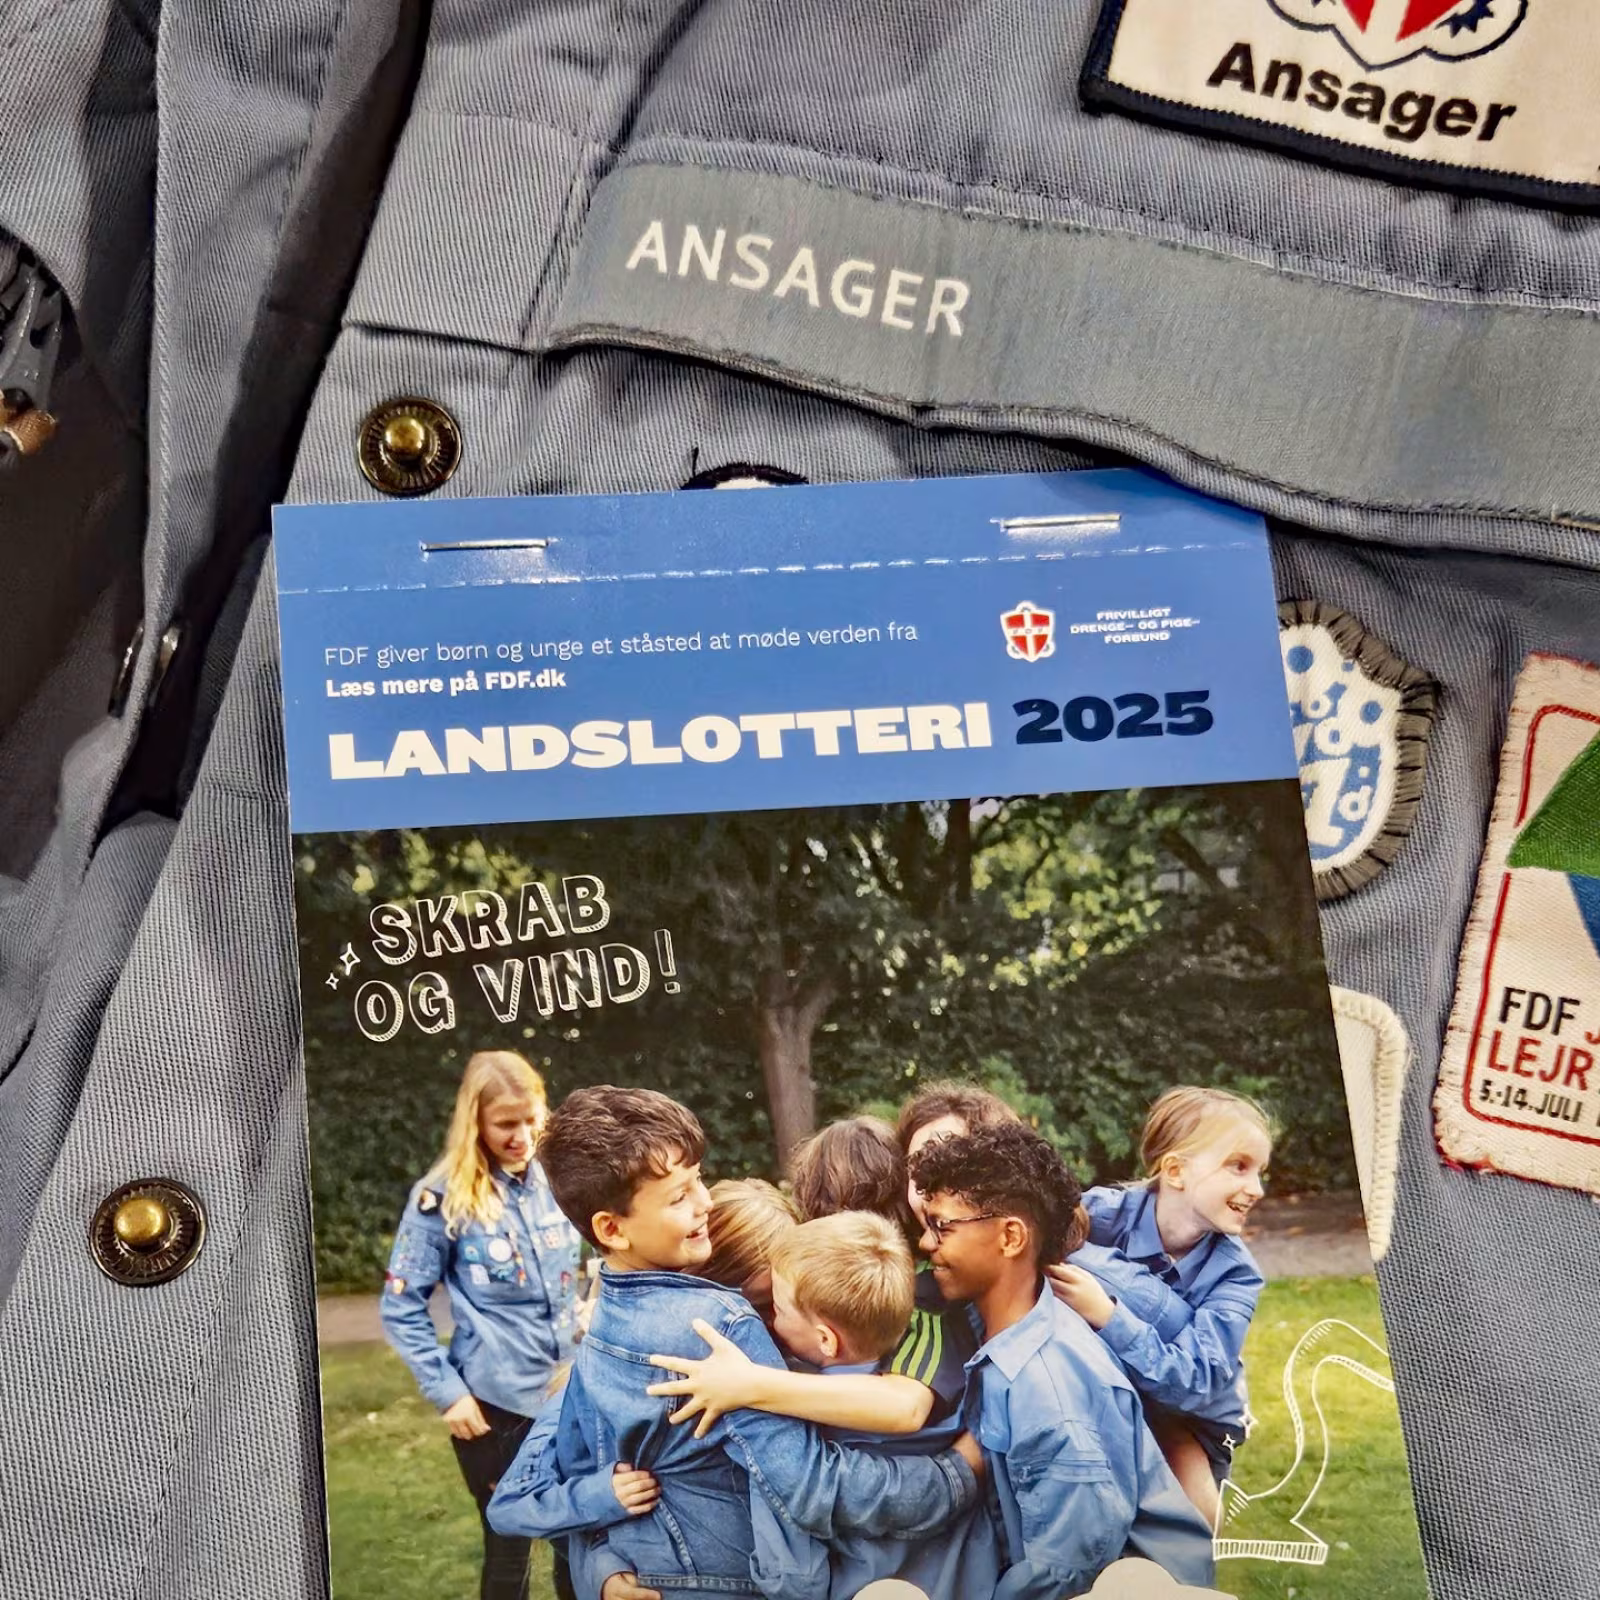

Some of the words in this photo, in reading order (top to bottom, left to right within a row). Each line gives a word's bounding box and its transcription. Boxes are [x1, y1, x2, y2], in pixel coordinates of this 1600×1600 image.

[1206, 41, 1518, 143] Ansager
[625, 219, 970, 338] ANSAGER
[1096, 607, 1172, 621] FRIVILLIGT
[1103, 631, 1171, 645] FORBUND
[1138, 620, 1158, 630] OG
[325, 646, 369, 666] FDF
[377, 643, 429, 669] giver
[437, 641, 489, 662] børn
[496, 642, 522, 662] og
[530, 637, 583, 661] unge
[591, 637, 613, 655] et
[620, 630, 702, 655] ståsted
[709, 631, 732, 651] at
[738, 627, 801, 648] møde
[807, 624, 881, 645] verden
[887, 620, 919, 641] fra
[325, 678, 376, 698] Læs
[381, 677, 444, 696] mere
[449, 670, 479, 697] på
[485, 668, 567, 691] FDF.dk
[328, 702, 992, 780] LANDSLOTTERI
[1011, 689, 1214, 745] 2025
[369, 874, 611, 966] SKRAB
[354, 970, 456, 1042] OG
[472, 927, 681, 1023] VIND!
[1497, 986, 1581, 1036] FDF
[1486, 1029, 1594, 1091] LEJR
